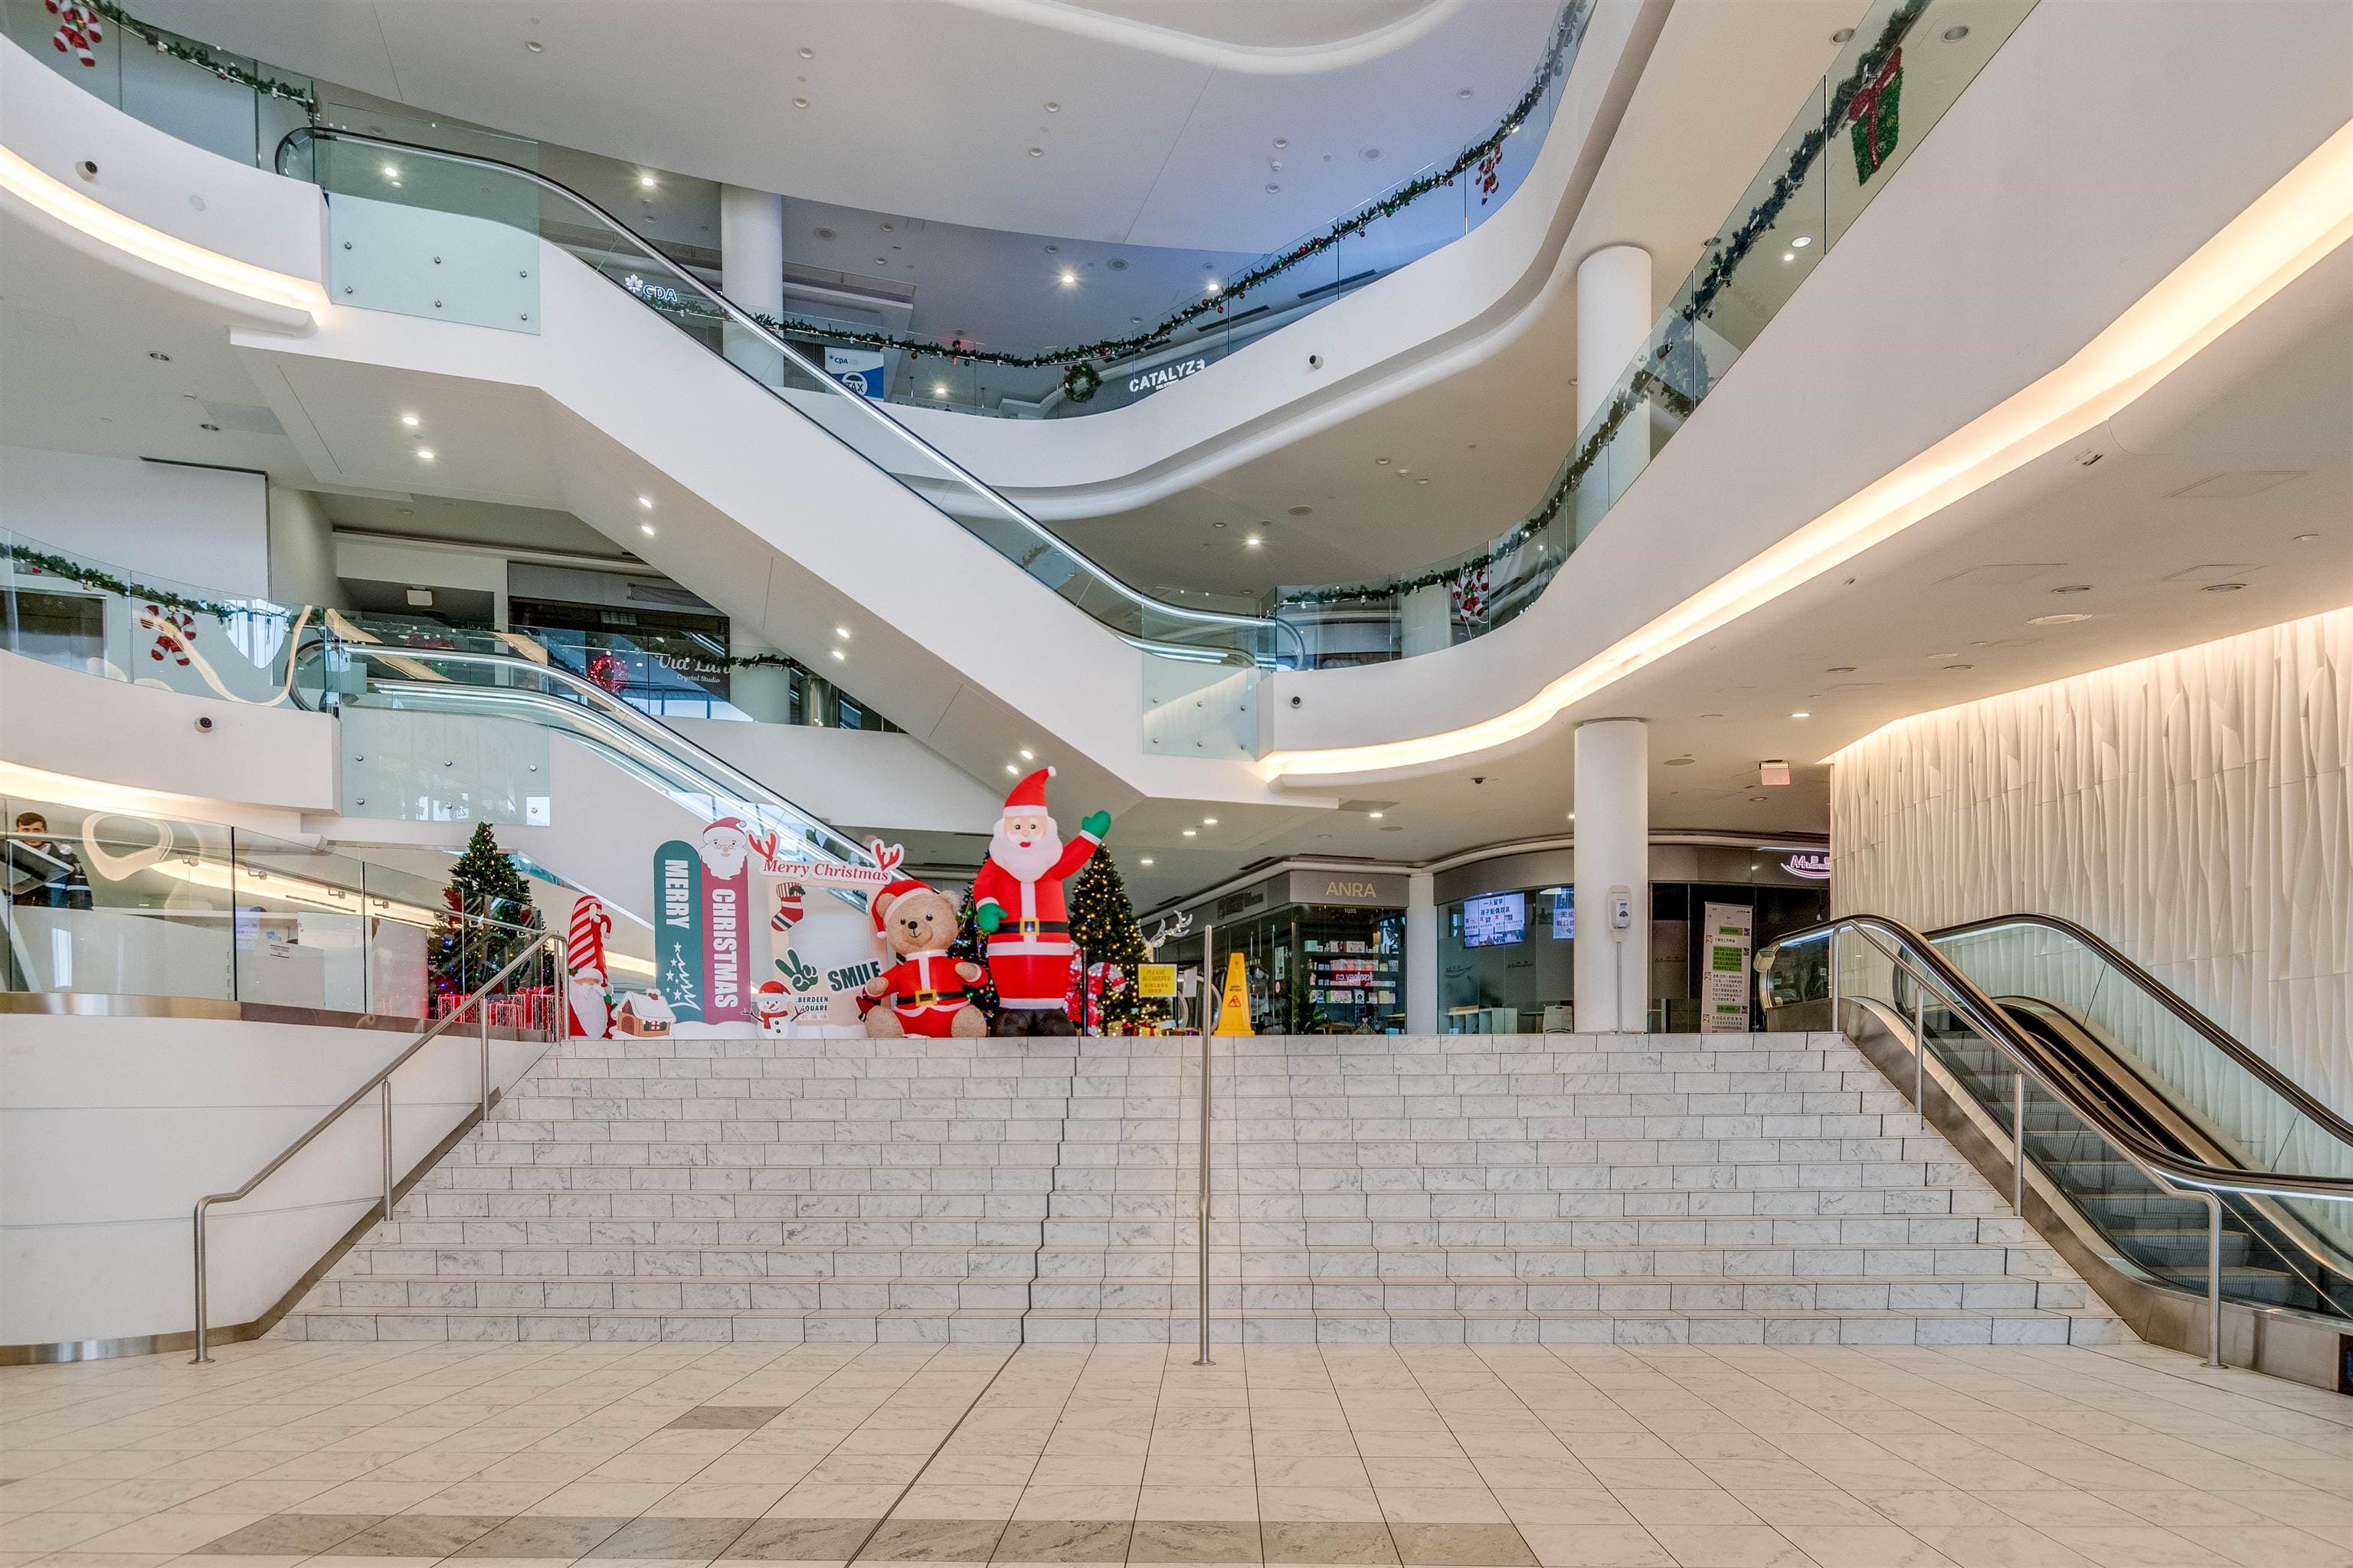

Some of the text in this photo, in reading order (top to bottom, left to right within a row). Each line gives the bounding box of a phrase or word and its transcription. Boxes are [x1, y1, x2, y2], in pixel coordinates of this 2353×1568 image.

[643, 285, 677, 301] CDA
[846, 382, 863, 392] TAX
[677, 674, 699, 683] Crystal
[764, 859, 889, 881] Merry Christmas
[665, 859, 690, 929] MERRY
[1326, 882, 1376, 898] ANRA
[712, 889, 738, 1009] CHRISTMAS
